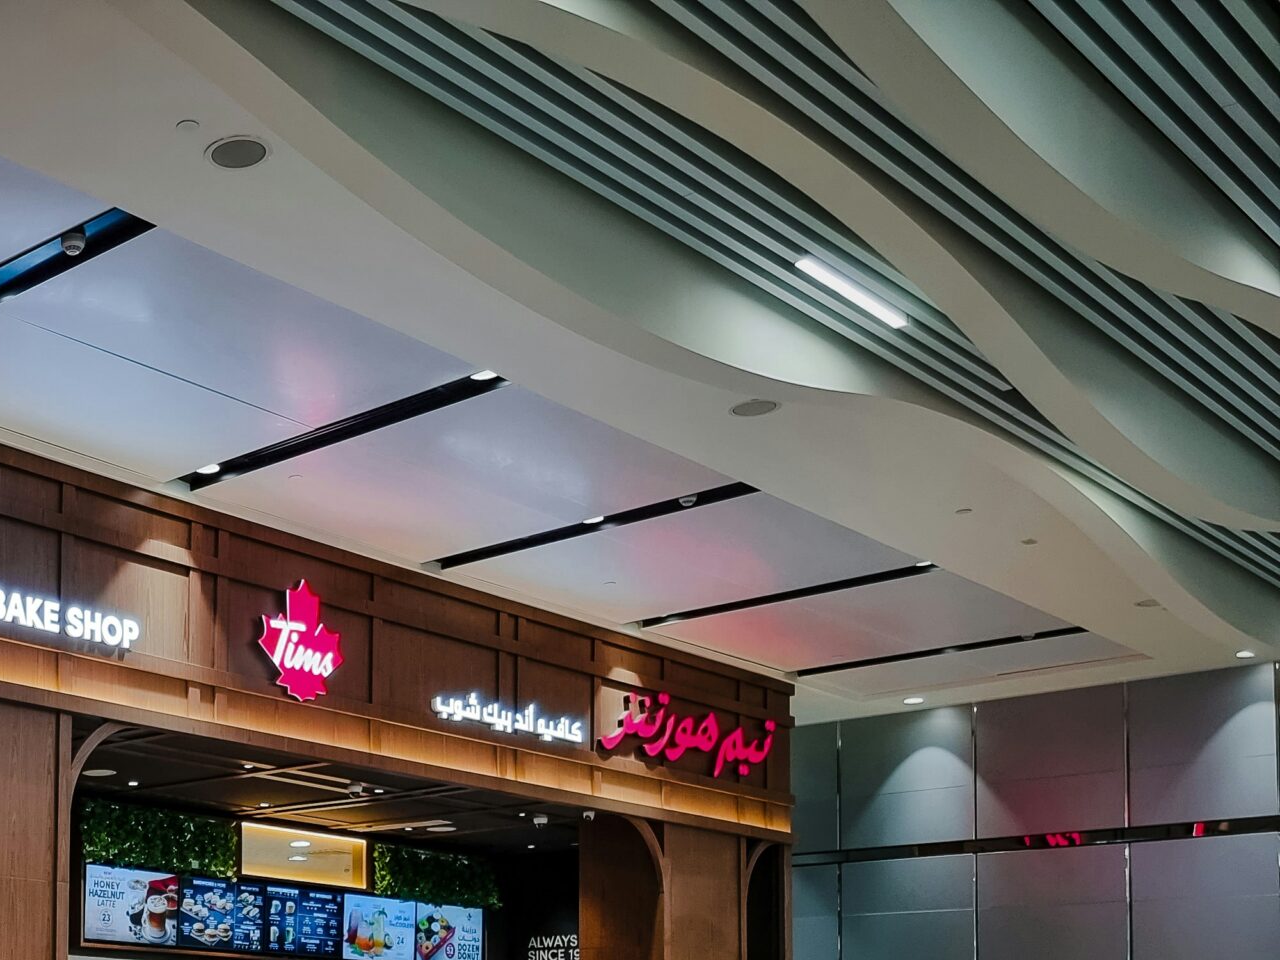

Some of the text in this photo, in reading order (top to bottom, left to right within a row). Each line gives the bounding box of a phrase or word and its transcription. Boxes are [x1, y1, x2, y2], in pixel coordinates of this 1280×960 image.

[66, 607, 139, 648] SHOP
[270, 619, 333, 678] Tims
[432, 692, 480, 721] شوب
[482, 703, 513, 733] بيك
[515, 703, 534, 732] أند
[601, 691, 776, 778] تيم هورتنز
[93, 880, 120, 890] HONEY
[88, 889, 125, 900] HAZELNUT
[97, 900, 116, 908] LATTE
[102, 913, 111, 922] 23
[457, 943, 480, 953] DOZEN
[528, 934, 578, 949] ALWAYS
[457, 952, 480, 960] DONUT
[569, 948, 580, 960] 19
